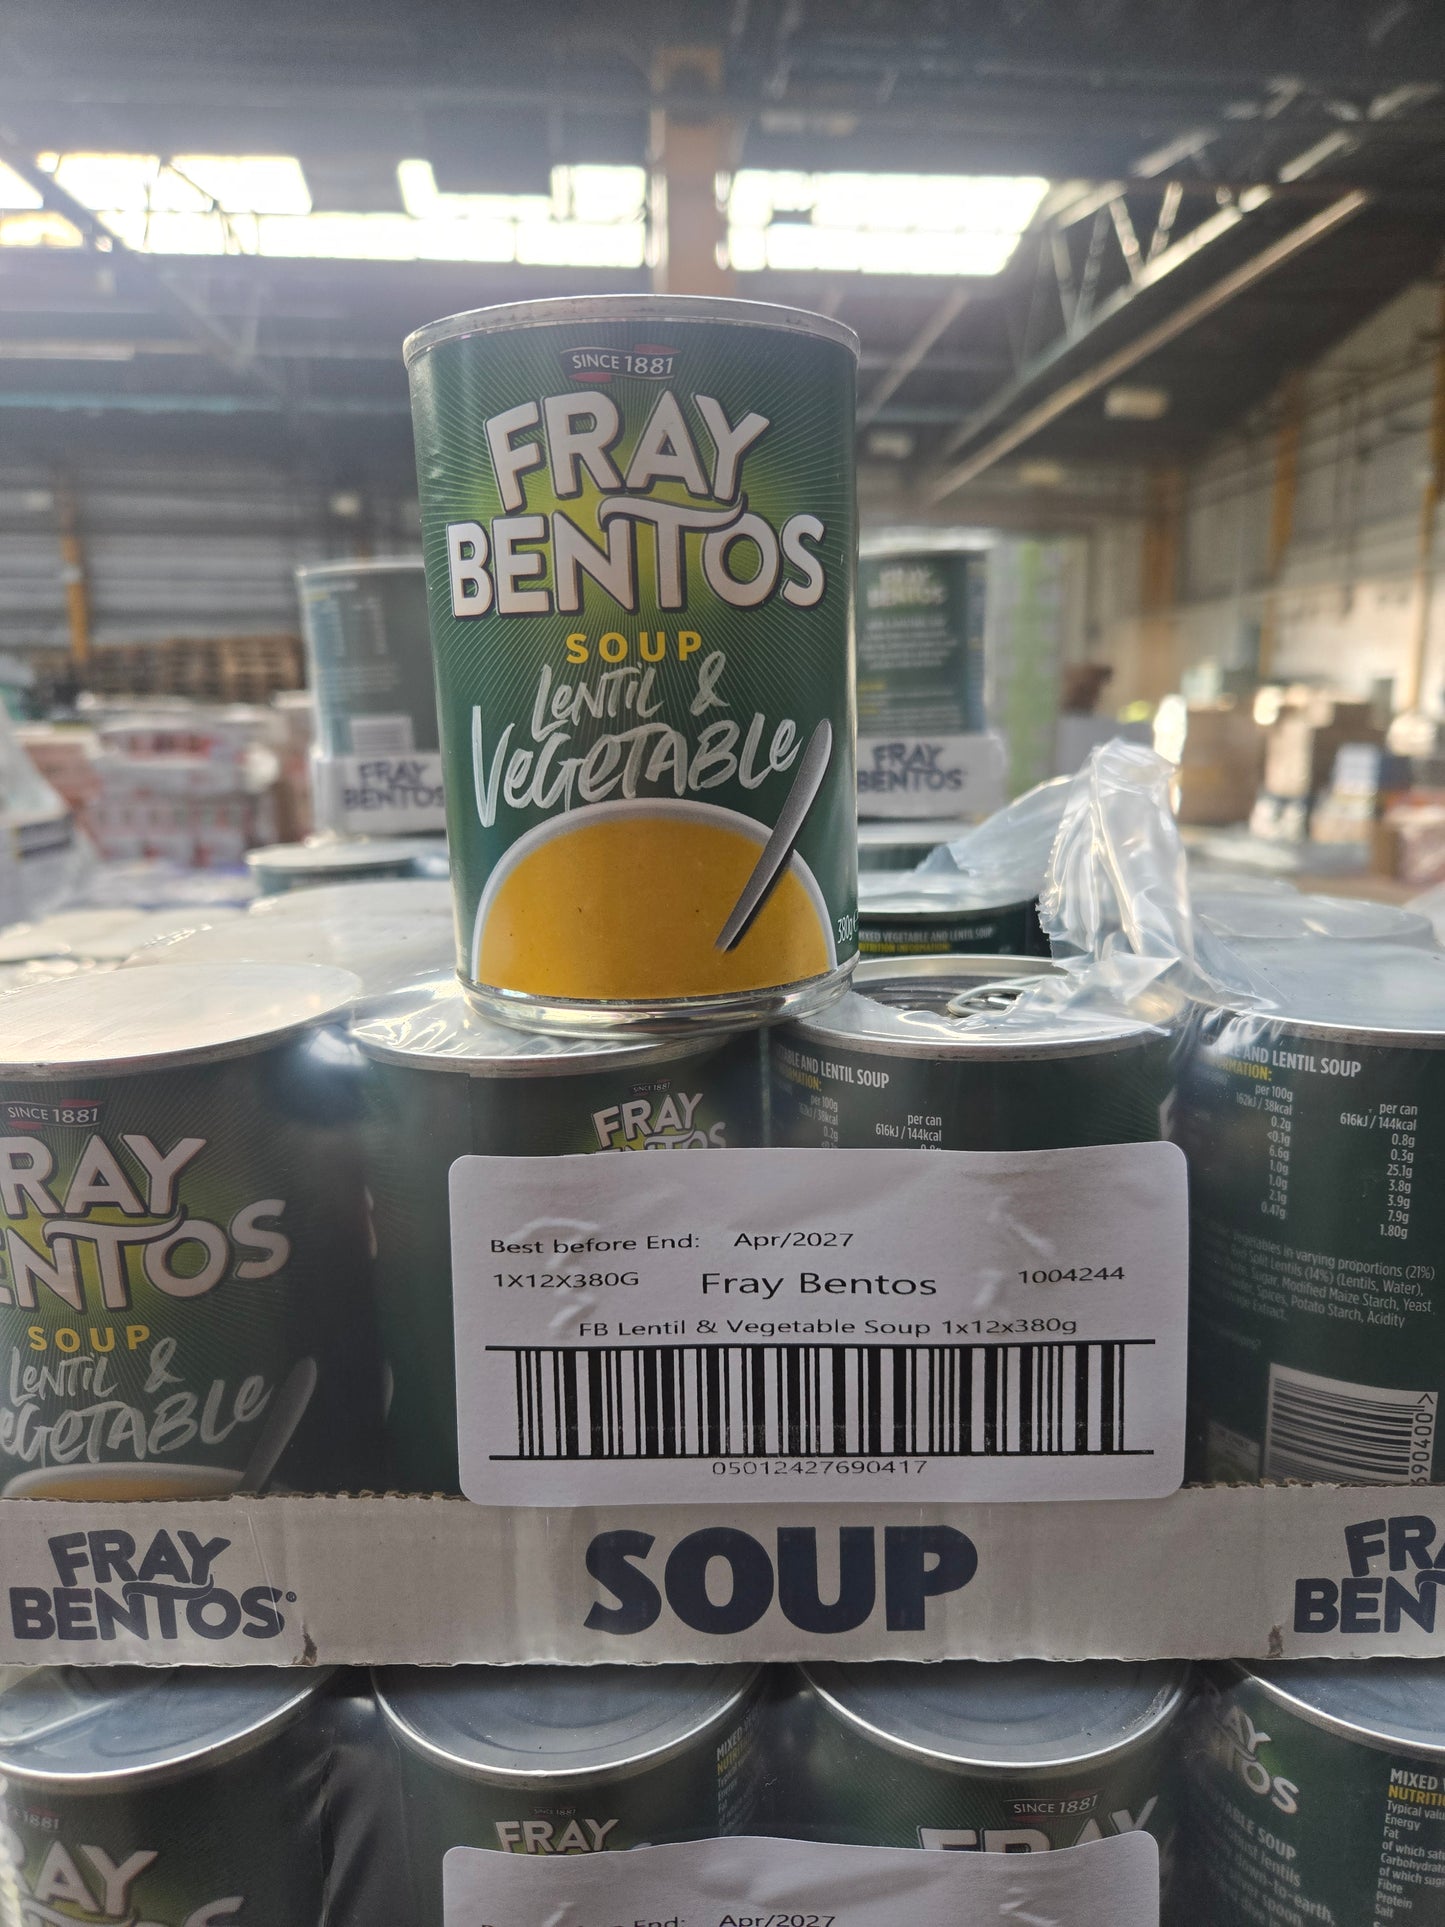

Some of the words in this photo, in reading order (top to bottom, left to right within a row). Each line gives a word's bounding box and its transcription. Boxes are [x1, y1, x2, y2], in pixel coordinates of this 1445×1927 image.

[572, 354, 619, 370] SINCE
[624, 355, 674, 374] 1881
[485, 389, 770, 513] FRAY
[447, 495, 826, 617] BENTOS
[566, 631, 702, 663] SOUP
[690, 651, 731, 716] &
[872, 743, 943, 770] FRAY
[837, 914, 853, 943] 380g
[1243, 1046, 1269, 1063] AND
[1272, 1050, 1316, 1073] LENTIL
[1320, 1057, 1361, 1078] SOUP
[801, 1055, 819, 1074] AND
[821, 1060, 854, 1083] LENTIL
[857, 1069, 890, 1088] SOUP
[1255, 1084, 1269, 1096] per
[1272, 1086, 1293, 1102] 100g
[822, 1096, 838, 1112] 100g
[1264, 1099, 1292, 1115] 38kcal
[1379, 1103, 1397, 1116] per
[1400, 1104, 1417, 1115] can
[7, 1106, 48, 1121] SINCE
[53, 1108, 97, 1123] 1881
[592, 1093, 703, 1147] FRAY
[907, 1114, 922, 1126] per
[925, 1115, 942, 1126] can
[1271, 1116, 1291, 1131] 0.2g
[1340, 1113, 1368, 1127] 616kJ
[1379, 1117, 1416, 1131] 144kcal
[824, 1126, 838, 1141] 0.2g
[875, 1123, 899, 1137] 616kJ
[907, 1127, 942, 1141] 144kcal
[1392, 1134, 1415, 1148] 0.8g
[1269, 1147, 1289, 1161] 6.6g
[1390, 1149, 1413, 1163] 0.3g
[1269, 1160, 1289, 1176] 1.0g
[1387, 1164, 1412, 1178] 25.1g
[1269, 1175, 1288, 1191] 1.0g
[1388, 1180, 1411, 1194] 3.8g
[1269, 1190, 1287, 1205] 2.1g
[1387, 1195, 1410, 1209] 3.9g
[1261, 1203, 1286, 1220] 0.47g
[1387, 1210, 1409, 1224] 7.9g
[1379, 1224, 1408, 1239] 1.80g
[490, 1239, 544, 1254] Best
[553, 1237, 637, 1254] before
[647, 1233, 700, 1250] End:
[734, 1232, 854, 1250] Apr/2027
[1296, 1251, 1335, 1270] varying
[1338, 1258, 1402, 1277] proportions
[1405, 1265, 1435, 1281] (21%)
[493, 1272, 640, 1289] 1X12X380G
[702, 1272, 785, 1300] Fray
[800, 1271, 938, 1296] Bentos
[1018, 1266, 1126, 1284] 1004244
[1270, 1257, 1302, 1277] Lentils
[1305, 1266, 1334, 1285] (14%)
[1336, 1273, 1379, 1292] (Lentils,
[1382, 1281, 1424, 1297] Water),
[1282, 1276, 1327, 1298] Modified
[1329, 1287, 1360, 1304] Maize
[1362, 1293, 1399, 1311] Starch,
[1403, 1299, 1432, 1313] Yeast
[1291, 1296, 1325, 1315] Potato
[1328, 1305, 1364, 1323] Starch,
[1367, 1311, 1405, 1328] Acidity
[579, 1322, 608, 1337] FB
[618, 1320, 686, 1336] Lentil
[696, 1320, 719, 1334] &
[726, 1318, 855, 1338] Vegetable
[864, 1319, 930, 1337] Soup
[942, 1318, 1078, 1336] 1x12x380g
[28, 1324, 151, 1353] SOUP
[144, 1337, 185, 1393] &
[712, 1460, 928, 1476] 05012427690417
[1344, 1515, 1445, 1577] FR
[48, 1529, 232, 1587] FRAY
[583, 1525, 978, 1635] SOUP
[1294, 1571, 1445, 1633] BEN
[1390, 1768, 1438, 1791] MIXED
[1013, 1803, 1055, 1814] SINCE
[1059, 1795, 1098, 1814] 1881
[1387, 1800, 1422, 1817] Typical
[1385, 1813, 1421, 1831] Energy
[495, 1819, 619, 1853] FRAY
[1383, 1826, 1399, 1840] Fat
[1258, 1827, 1297, 1861] SOUP
[1382, 1841, 1393, 1851] of
[1395, 1844, 1425, 1858] which
[1262, 1851, 1301, 1887] lentils
[1379, 1867, 1390, 1877] of
[1392, 1870, 1422, 1885] which
[1377, 1878, 1403, 1894] Fibre
[1376, 1891, 1413, 1909] Protein
[1374, 1903, 1394, 1918] Salt
[719, 1914, 836, 1927] Apr/2027
